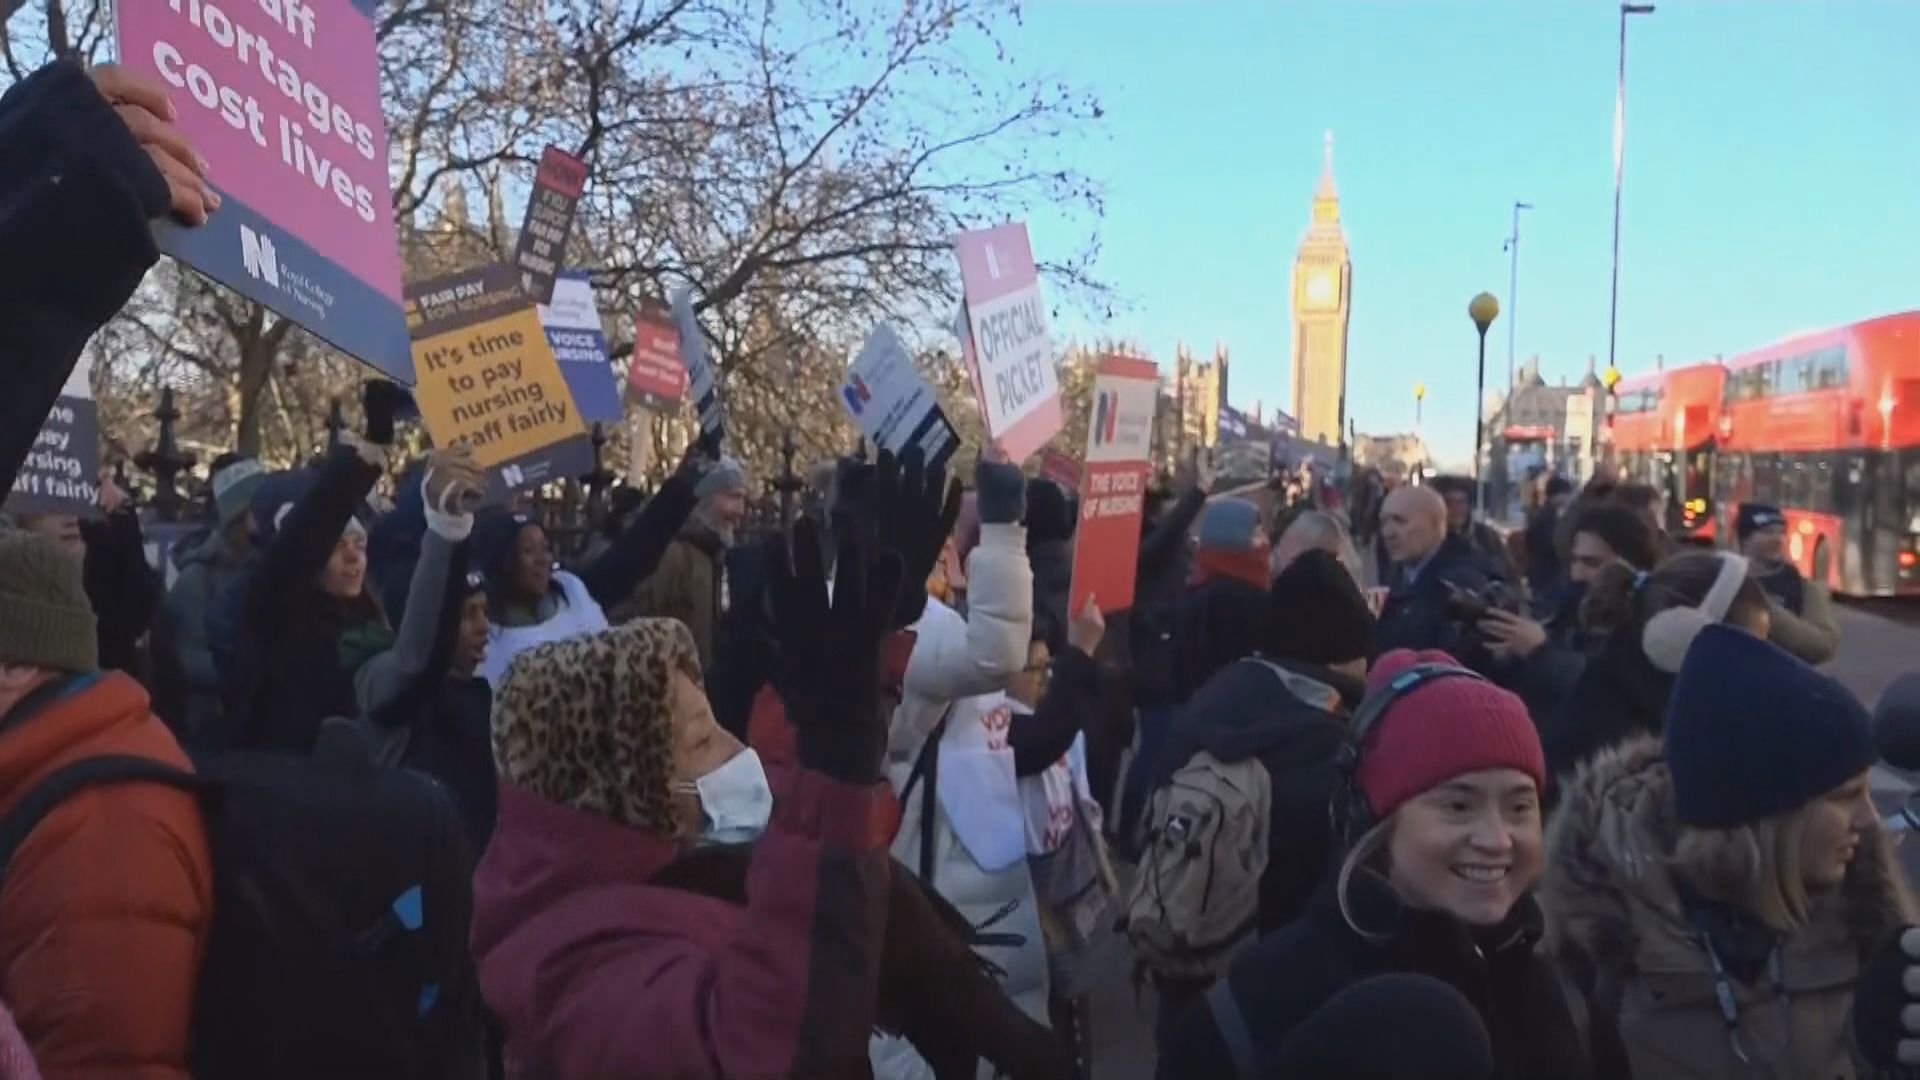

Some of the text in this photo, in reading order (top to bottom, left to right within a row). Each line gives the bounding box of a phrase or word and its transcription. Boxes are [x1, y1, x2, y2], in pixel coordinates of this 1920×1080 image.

[279, 114, 376, 222] lives
[420, 280, 484, 308] FAIR PAY
[424, 330, 524, 372] It's time
[550, 331, 597, 348] VOICE
[979, 300, 1045, 364] OFFICIAL
[447, 357, 522, 394] to pay
[995, 351, 1046, 418] PICKET
[452, 381, 543, 424] nursing
[507, 400, 566, 434] fairly
